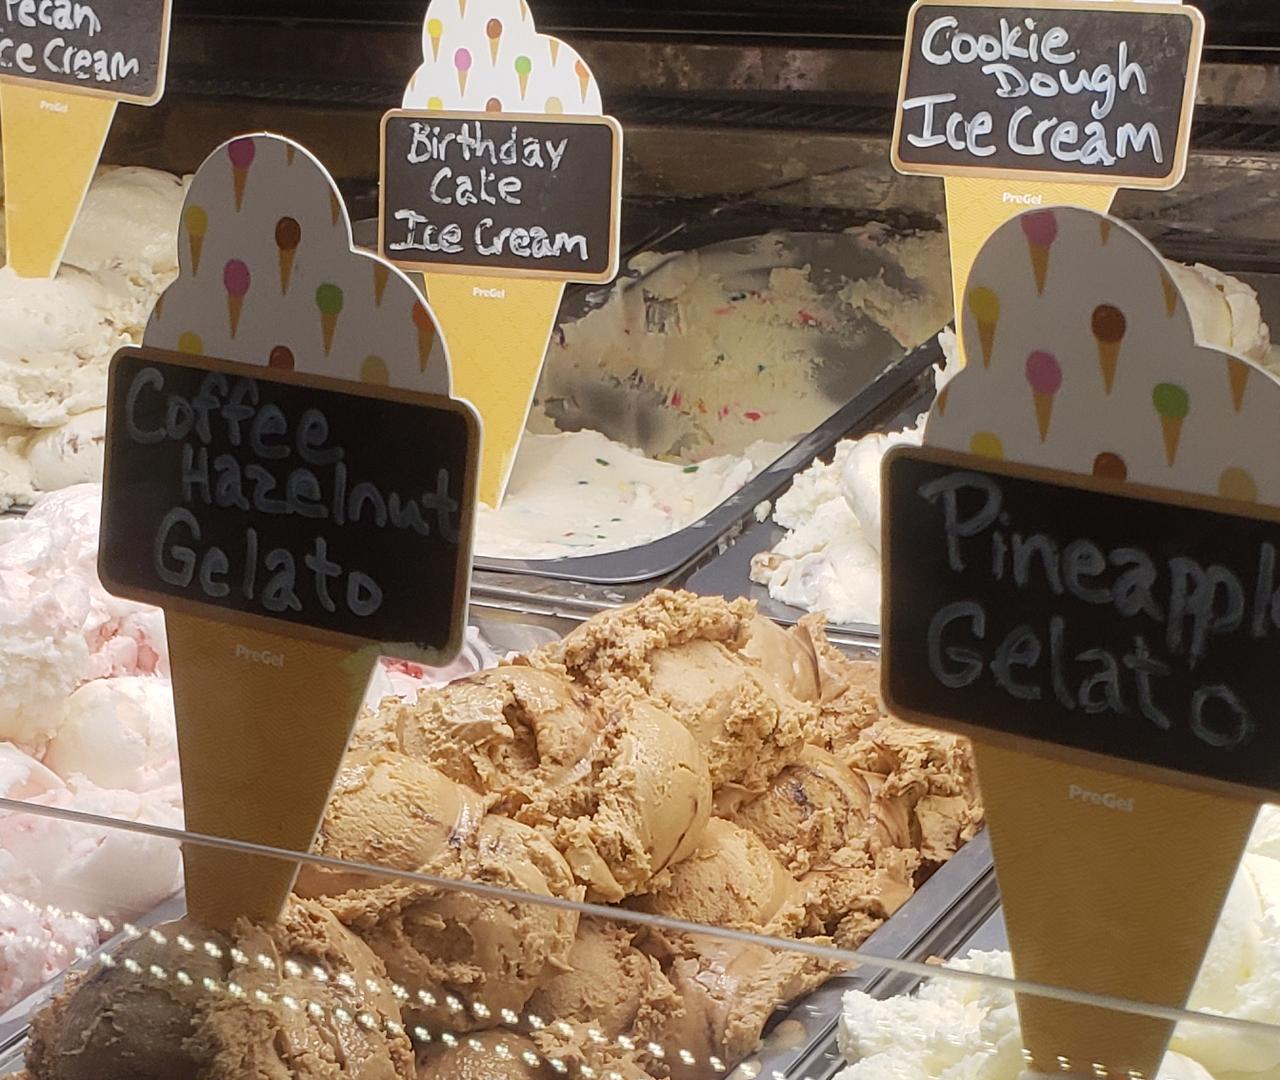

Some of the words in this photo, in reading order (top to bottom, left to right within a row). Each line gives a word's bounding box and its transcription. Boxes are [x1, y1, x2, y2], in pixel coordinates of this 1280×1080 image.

[43, 37, 139, 82] Cream
[921, 15, 1076, 65] Cookie
[982, 41, 1147, 119] Dough
[407, 121, 568, 171] Birthday
[902, 92, 997, 156] Ice
[1007, 105, 1163, 166] Cream
[390, 209, 463, 254] Ice
[474, 217, 588, 260] Cream
[124, 367, 345, 466] Coffee
[181, 443, 461, 545] Hazelnut
[156, 506, 384, 617] Gelato
[926, 601, 1256, 750] Gelato
